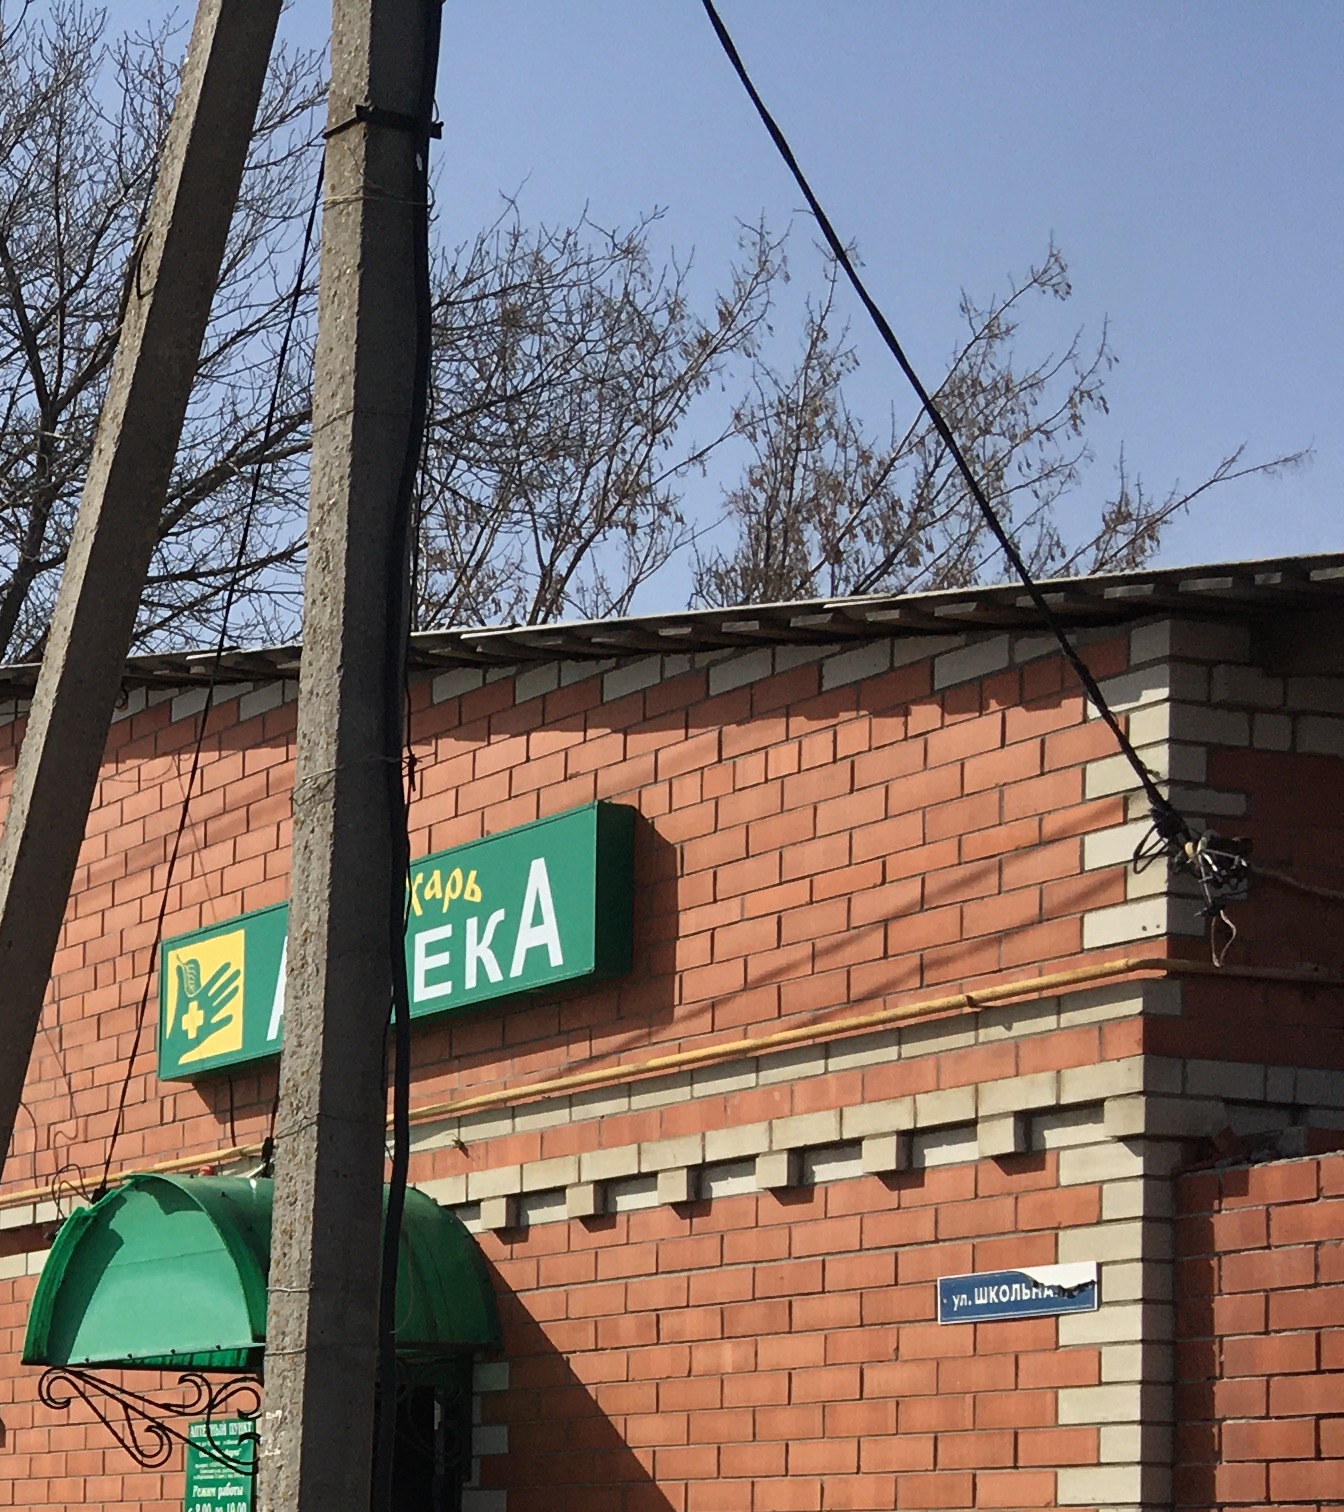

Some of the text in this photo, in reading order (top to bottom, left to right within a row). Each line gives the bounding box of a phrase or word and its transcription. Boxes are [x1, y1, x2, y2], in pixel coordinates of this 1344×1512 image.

[951, 1282, 1059, 1311] ул. ШКОЛЬНА
[192, 1481, 244, 1500] Режим работы
